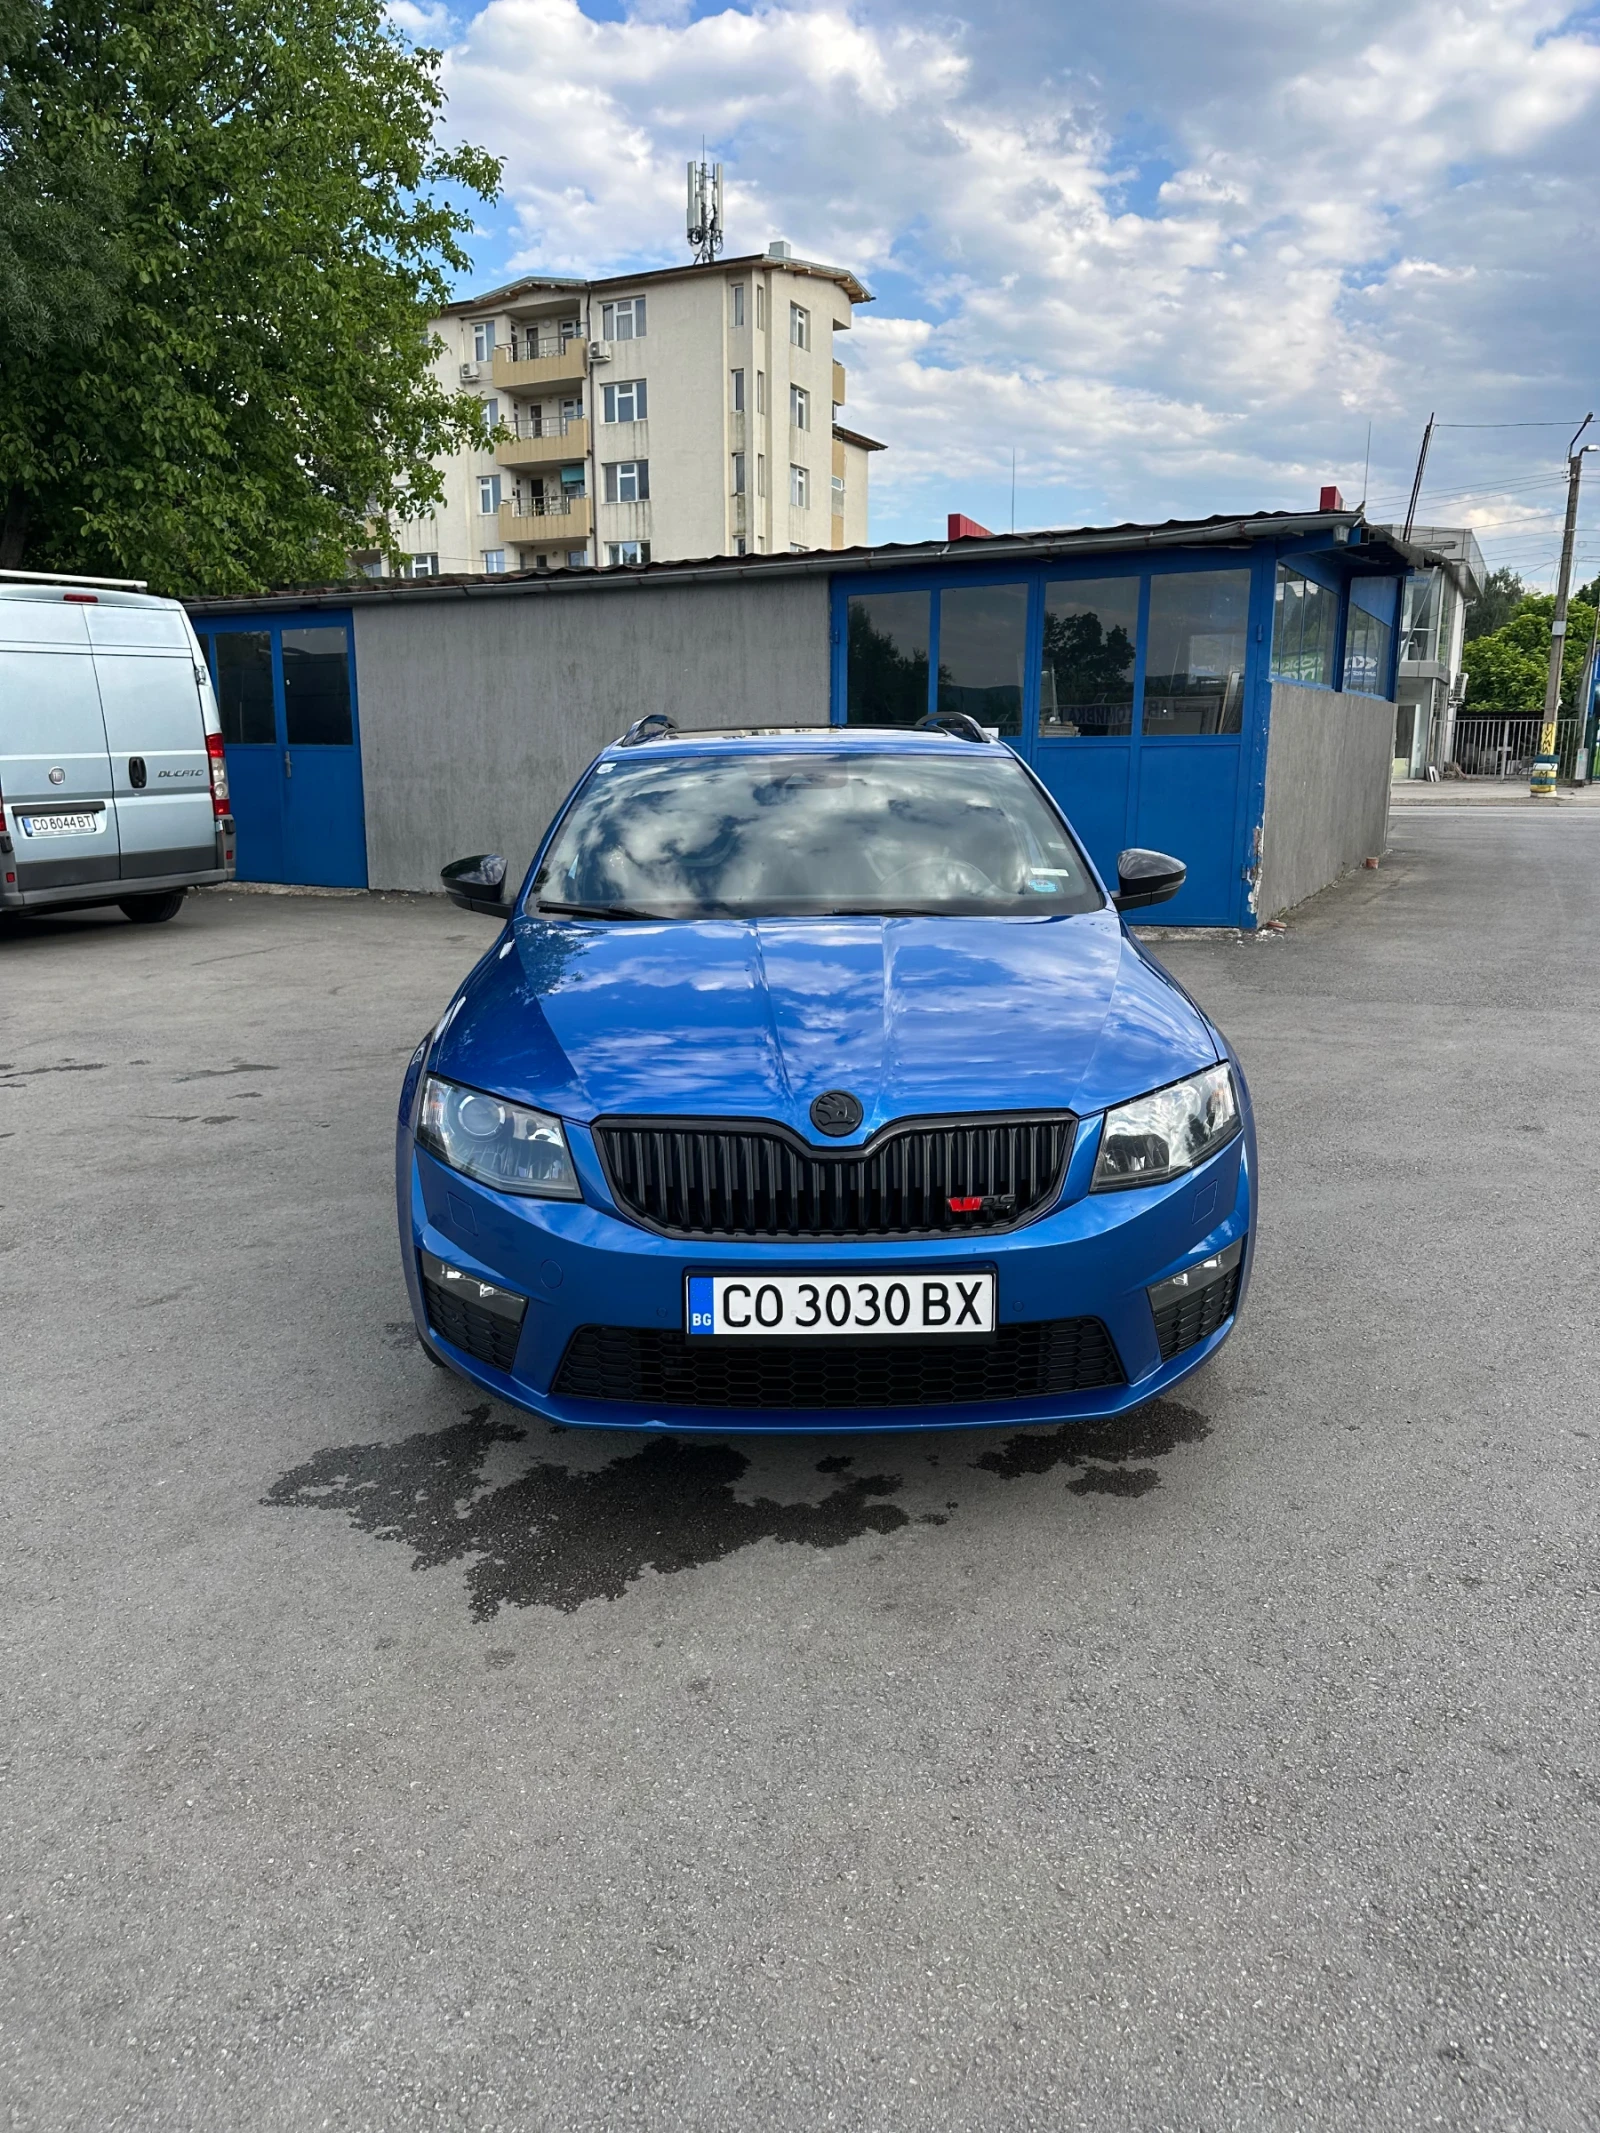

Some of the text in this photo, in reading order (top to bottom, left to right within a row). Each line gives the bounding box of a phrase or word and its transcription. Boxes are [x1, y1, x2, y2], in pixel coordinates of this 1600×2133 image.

[157, 769, 205, 778] DUCATO
[32, 815, 91, 831] CO 8044 BT
[722, 1281, 983, 1327] CO 3030 BX
[692, 1313, 712, 1326] BG
